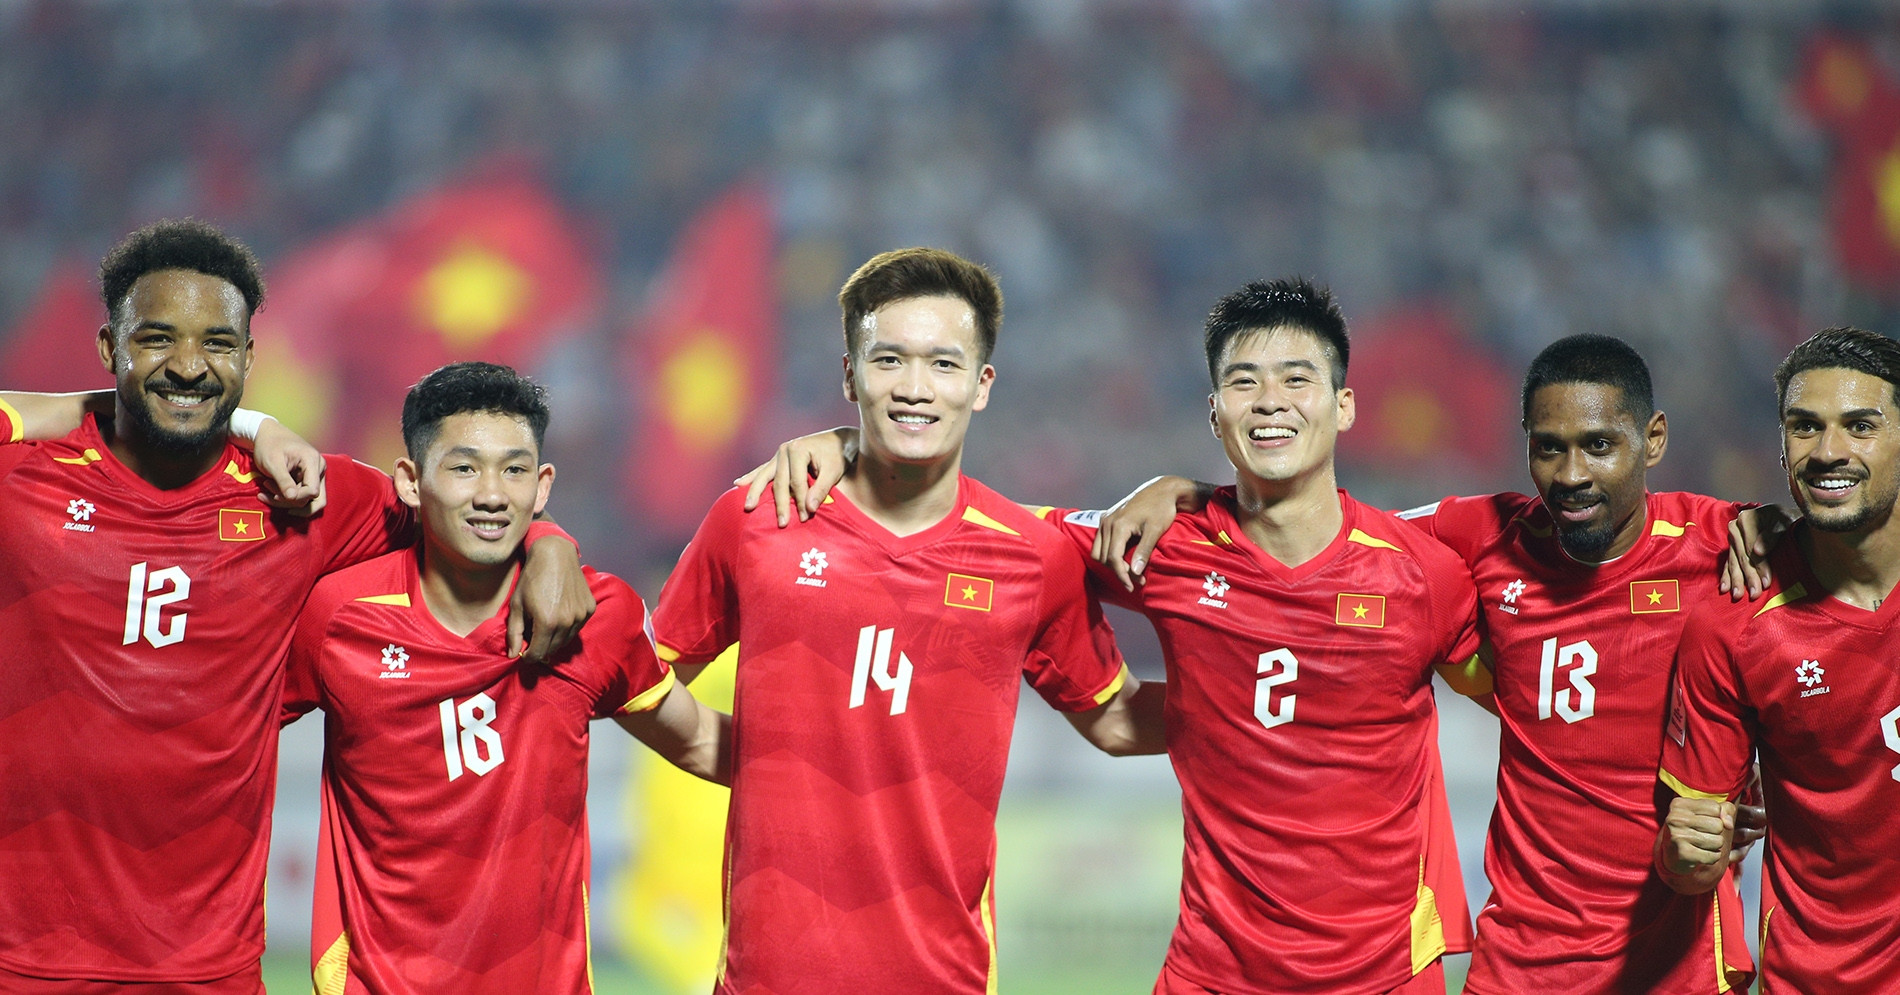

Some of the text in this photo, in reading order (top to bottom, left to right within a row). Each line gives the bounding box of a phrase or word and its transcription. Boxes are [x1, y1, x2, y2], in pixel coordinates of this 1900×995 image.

[123, 562, 191, 649] 12
[849, 625, 914, 716] 14
[1253, 647, 1298, 729] 2
[1537, 637, 1599, 724] 13
[439, 692, 504, 783] 18
